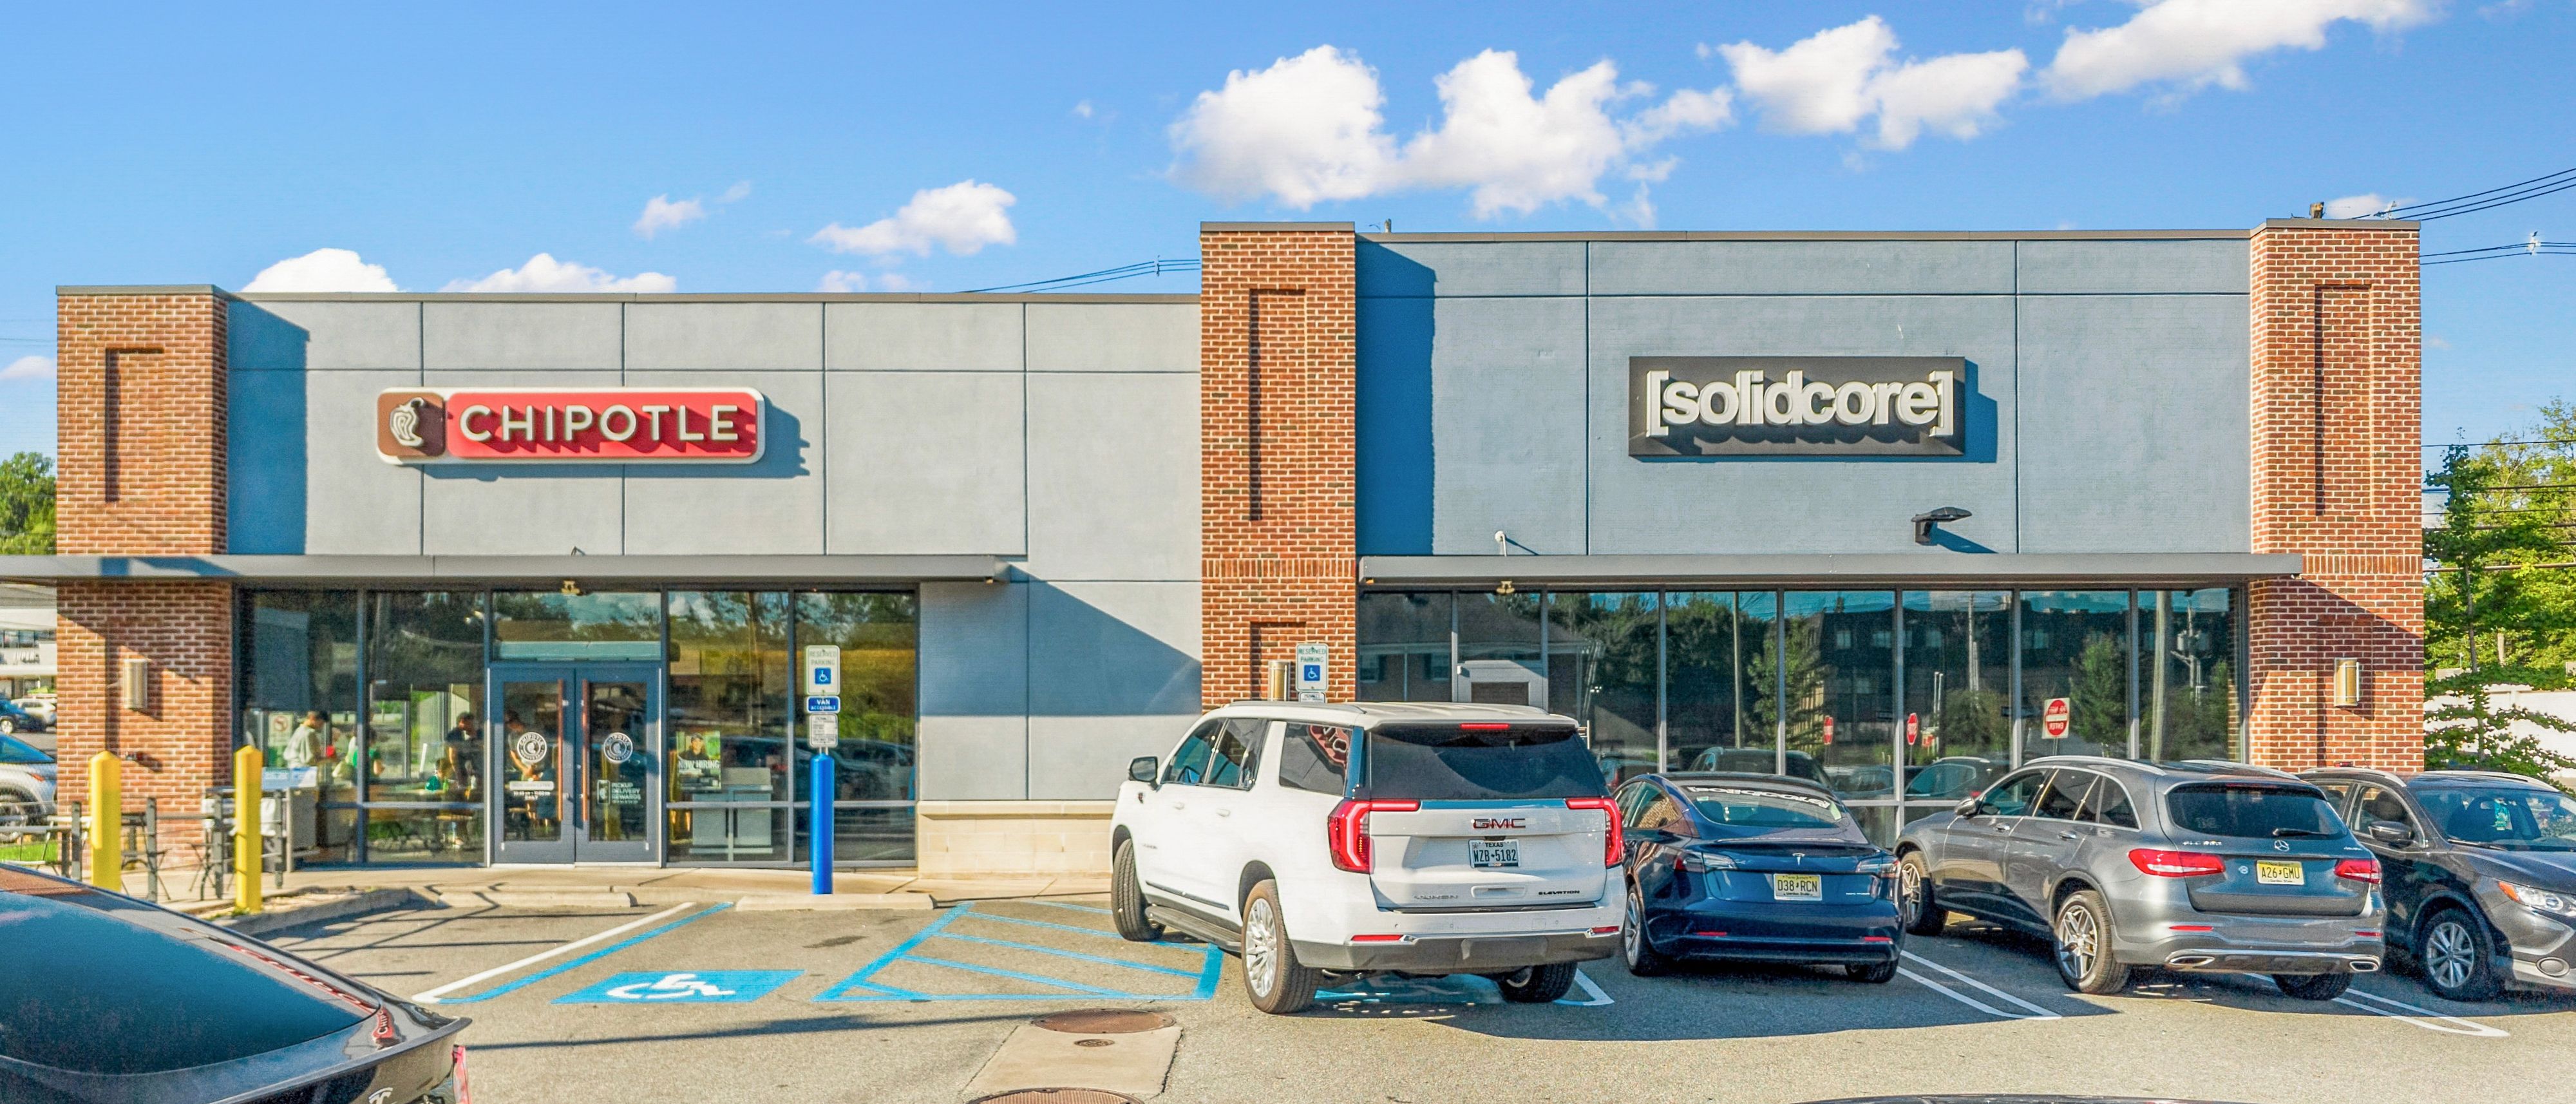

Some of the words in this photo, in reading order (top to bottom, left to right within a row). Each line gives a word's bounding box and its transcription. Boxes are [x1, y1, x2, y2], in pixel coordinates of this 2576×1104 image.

[460, 404, 739, 443] CHIPOTLE
[696, 759, 721, 768] HIRING
[1472, 818, 1526, 829] GMC
